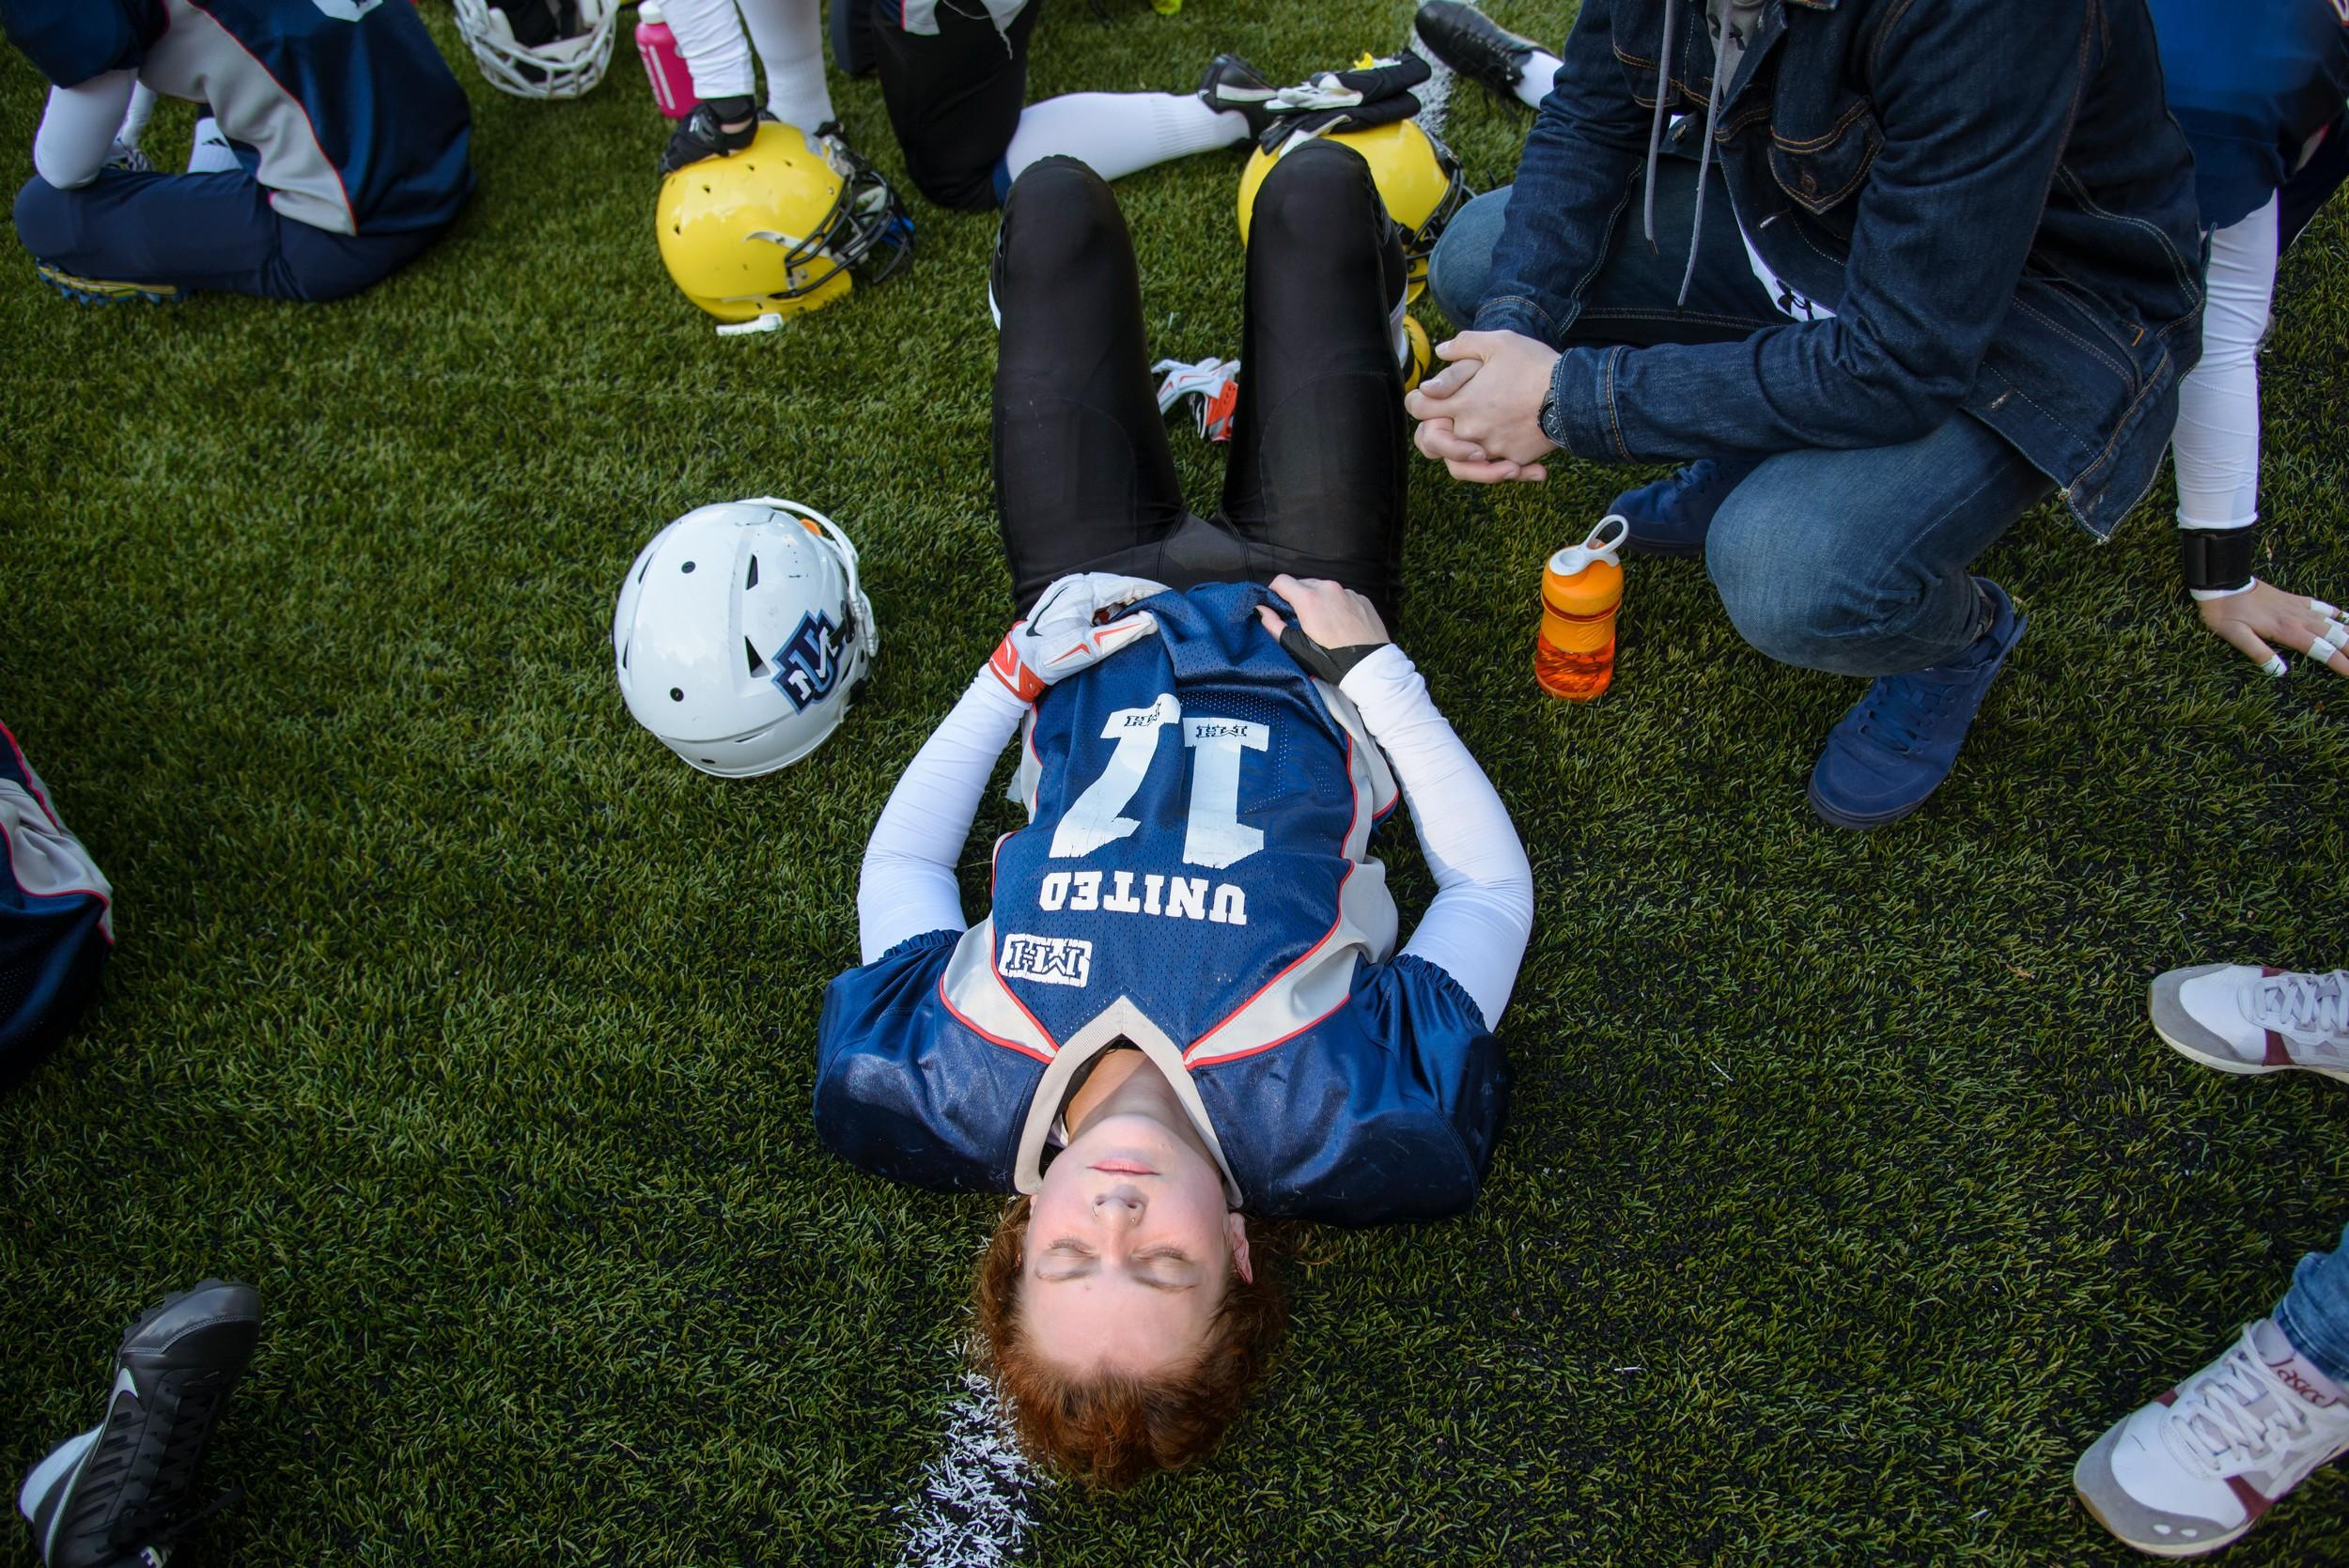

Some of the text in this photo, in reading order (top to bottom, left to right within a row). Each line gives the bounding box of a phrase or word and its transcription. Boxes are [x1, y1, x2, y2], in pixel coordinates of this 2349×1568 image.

[1195, 724, 1248, 738] MH
[1038, 870, 1248, 925] UNITED
[1003, 937, 1083, 981] MH
